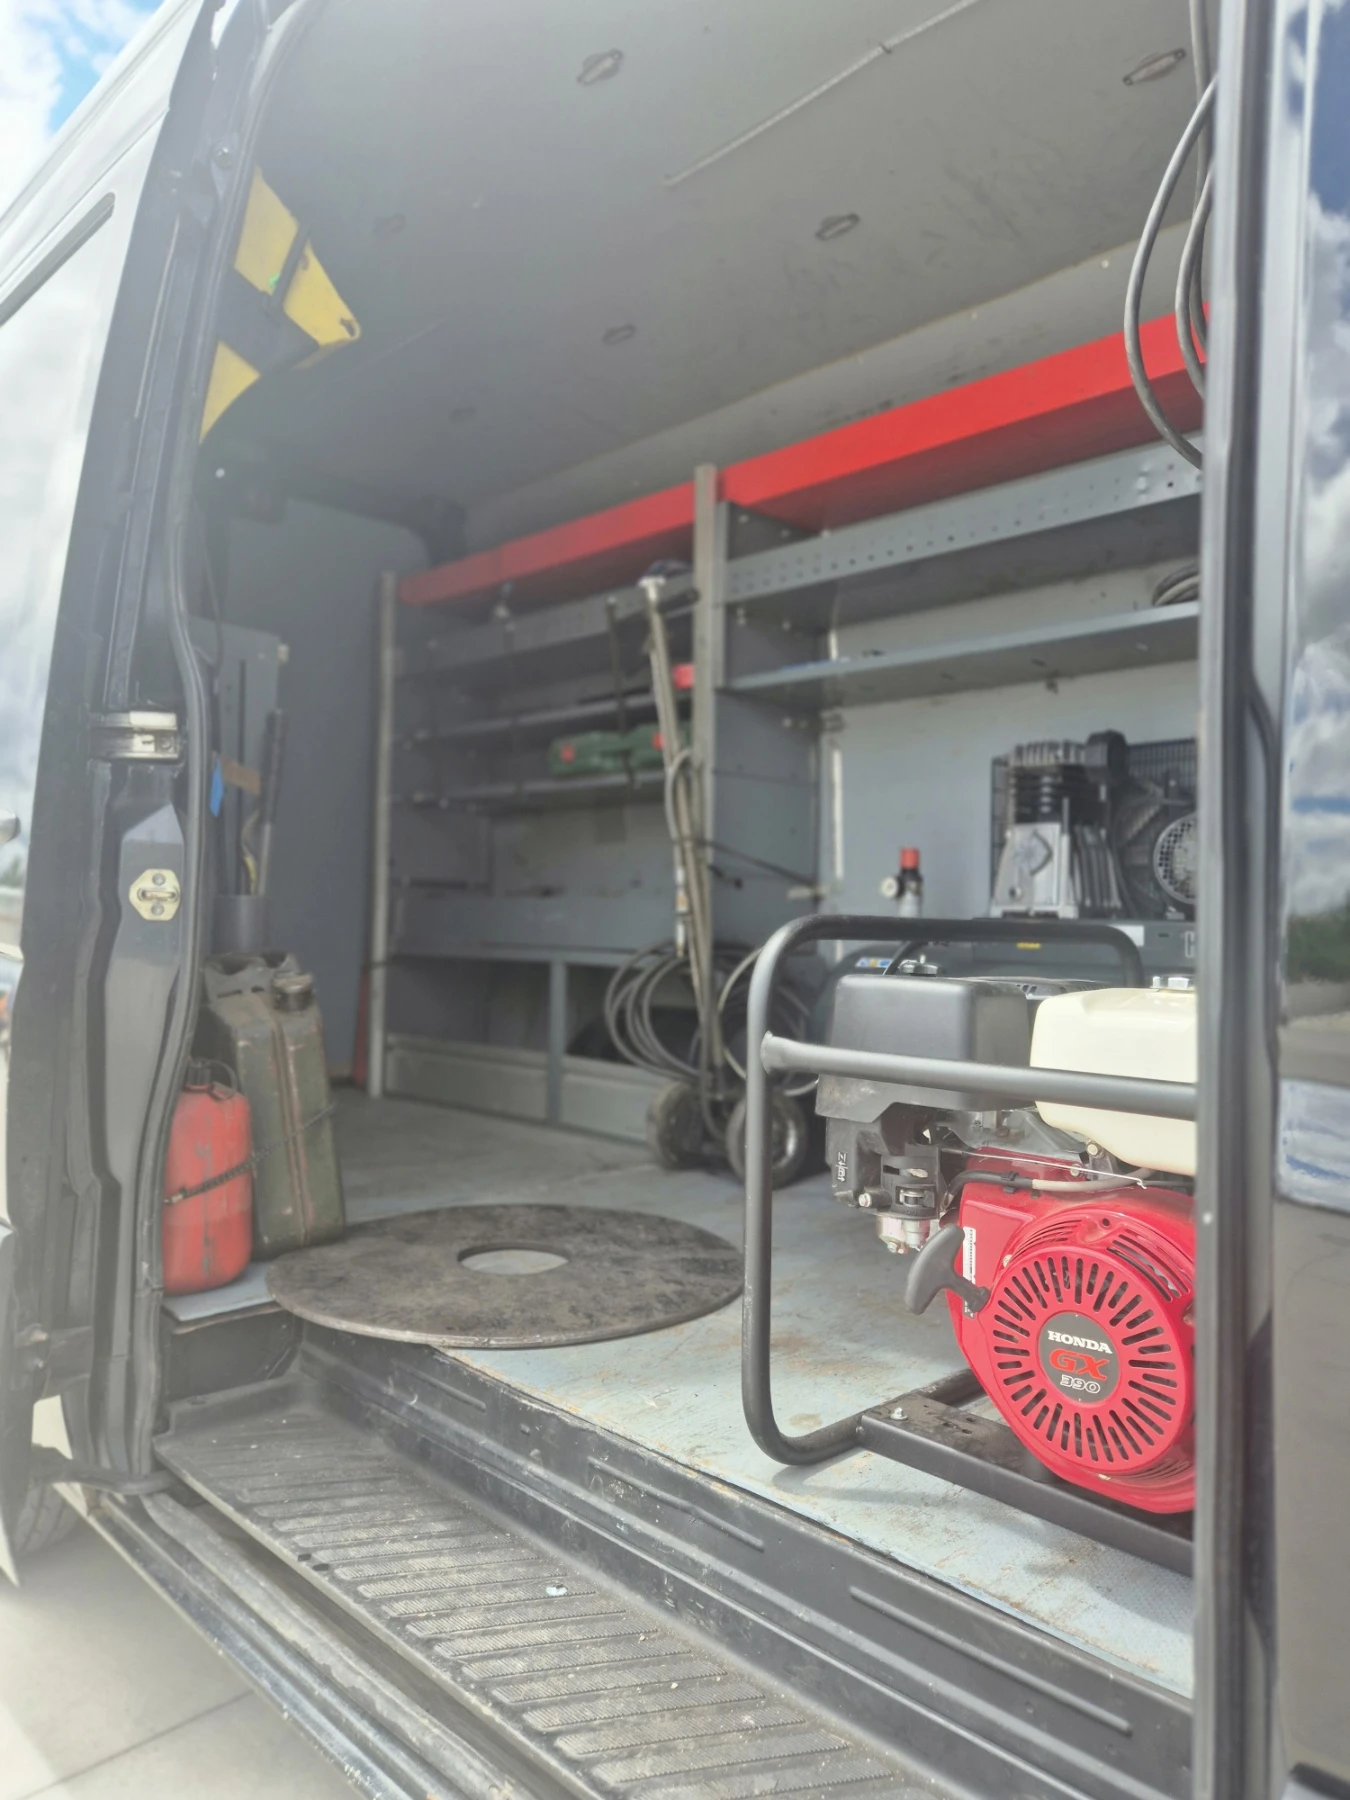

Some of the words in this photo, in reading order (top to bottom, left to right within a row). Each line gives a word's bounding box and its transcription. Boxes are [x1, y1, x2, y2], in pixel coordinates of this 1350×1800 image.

[1047, 1330, 1113, 1355] HONDA
[1049, 1348, 1111, 1381] GX
[1060, 1374, 1101, 1394] 390
